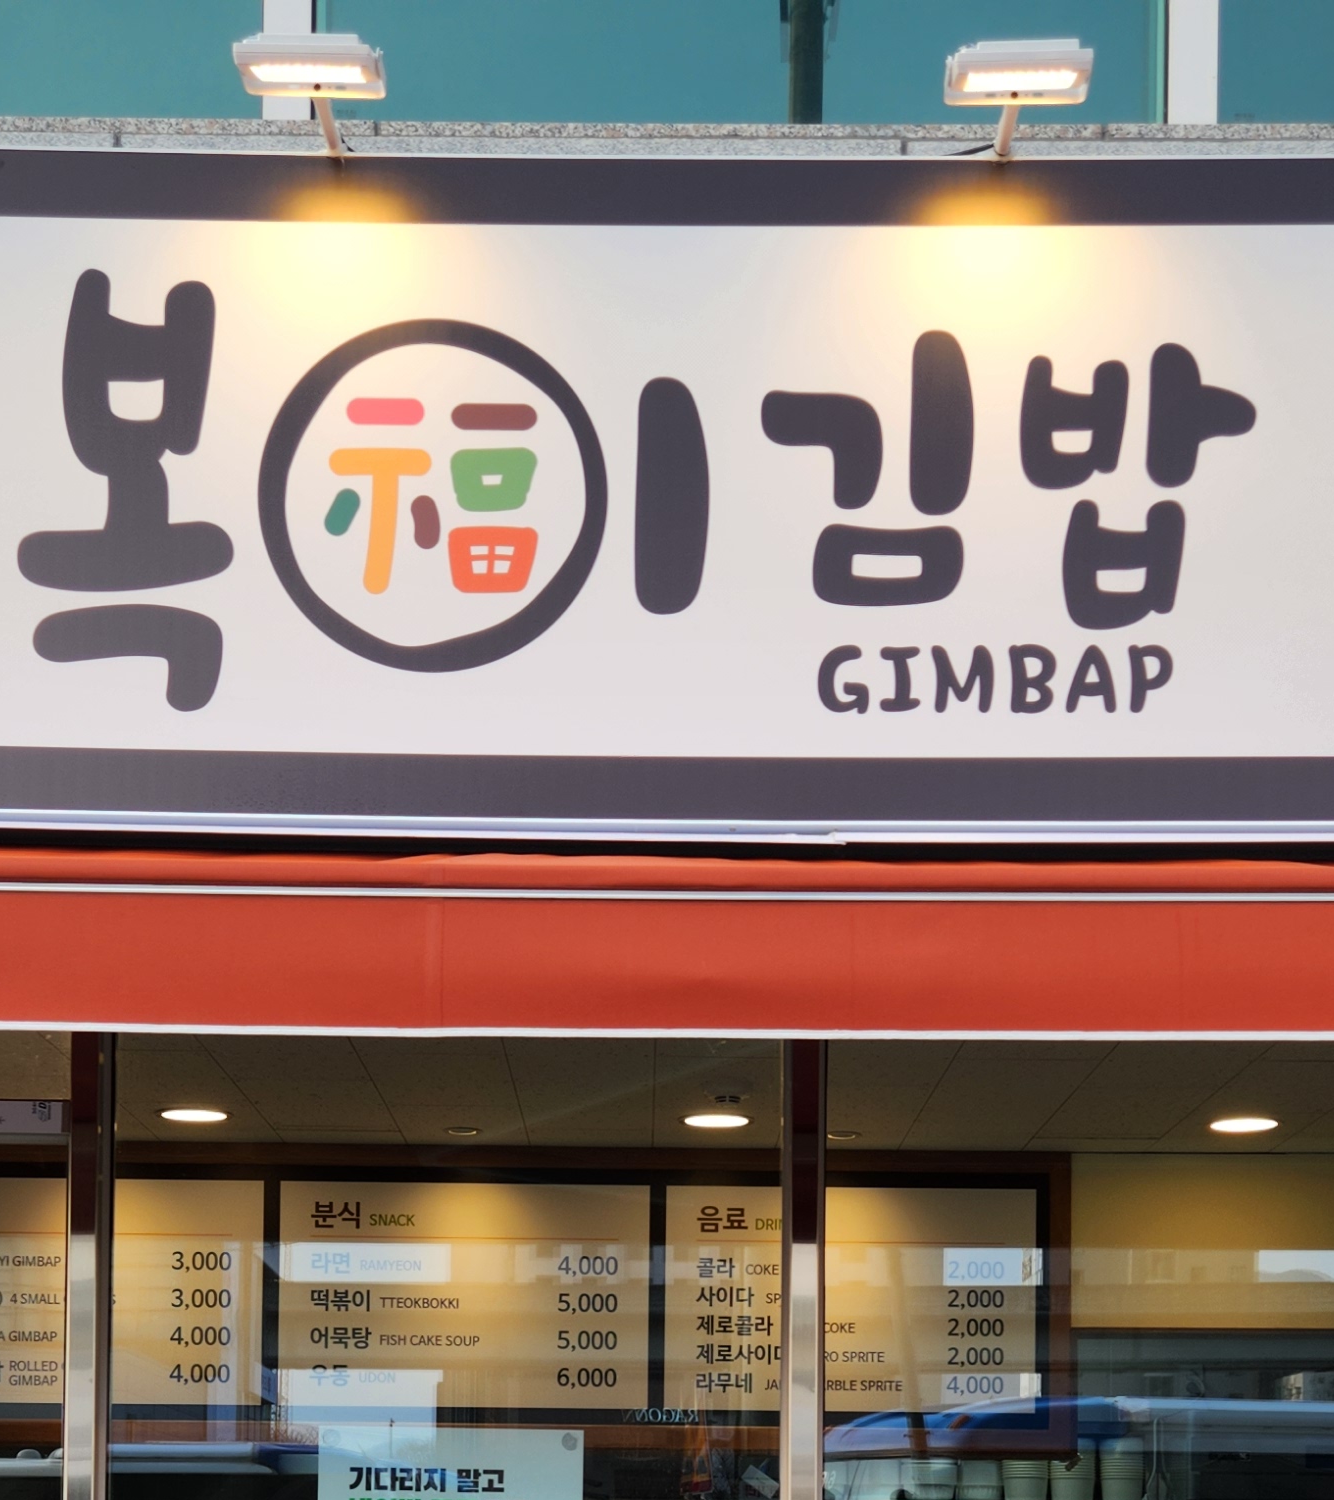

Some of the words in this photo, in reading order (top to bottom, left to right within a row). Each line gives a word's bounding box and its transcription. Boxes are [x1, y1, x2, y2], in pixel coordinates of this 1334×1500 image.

[818, 644, 1174, 714] GIMBAP
[310, 1201, 361, 1230] 분식
[369, 1214, 415, 1227] SNACK
[697, 1206, 748, 1233] 음료
[12, 1255, 61, 1268] GIMBAP
[171, 1251, 232, 1272] 3,000
[310, 1251, 351, 1275] 라면
[359, 1259, 422, 1272] RAMYEON
[557, 1256, 618, 1277] 4,000
[697, 1257, 735, 1279] 콜라
[745, 1264, 779, 1276] COKE
[947, 1260, 1005, 1280] 2,000
[20, 1294, 60, 1305] SMALL
[170, 1289, 231, 1311] 3,000
[310, 1289, 371, 1313] 떡볶이
[380, 1297, 459, 1309] TTEOKBOKKI
[557, 1293, 618, 1315] 5,000
[696, 1286, 754, 1307] 사이다
[947, 1290, 1005, 1310] 2,000
[8, 1330, 57, 1342] GIMBAP
[170, 1326, 231, 1347] 4,000
[696, 1315, 773, 1336] 제로콜라
[947, 1318, 1005, 1338] 2,000
[310, 1326, 372, 1350] 어묵탕
[380, 1335, 407, 1347] FISH
[409, 1335, 442, 1347] CAKE
[445, 1335, 480, 1347] SOUP
[557, 1330, 618, 1352] 5,000
[842, 1351, 885, 1363] SPRITE
[947, 1347, 1004, 1367] 2,000
[9, 1361, 58, 1372] ROLLED
[169, 1363, 230, 1385] 4,000
[9, 1375, 58, 1386] GIMBAP
[309, 1364, 350, 1387] 우동
[359, 1371, 396, 1384] UDON
[556, 1368, 617, 1389] 6,000
[696, 1373, 753, 1394] 라무네
[860, 1380, 903, 1392] SPRITE
[946, 1376, 1004, 1396] 4,000
[349, 1467, 446, 1492] 기다리지
[456, 1468, 505, 1493] 말고
